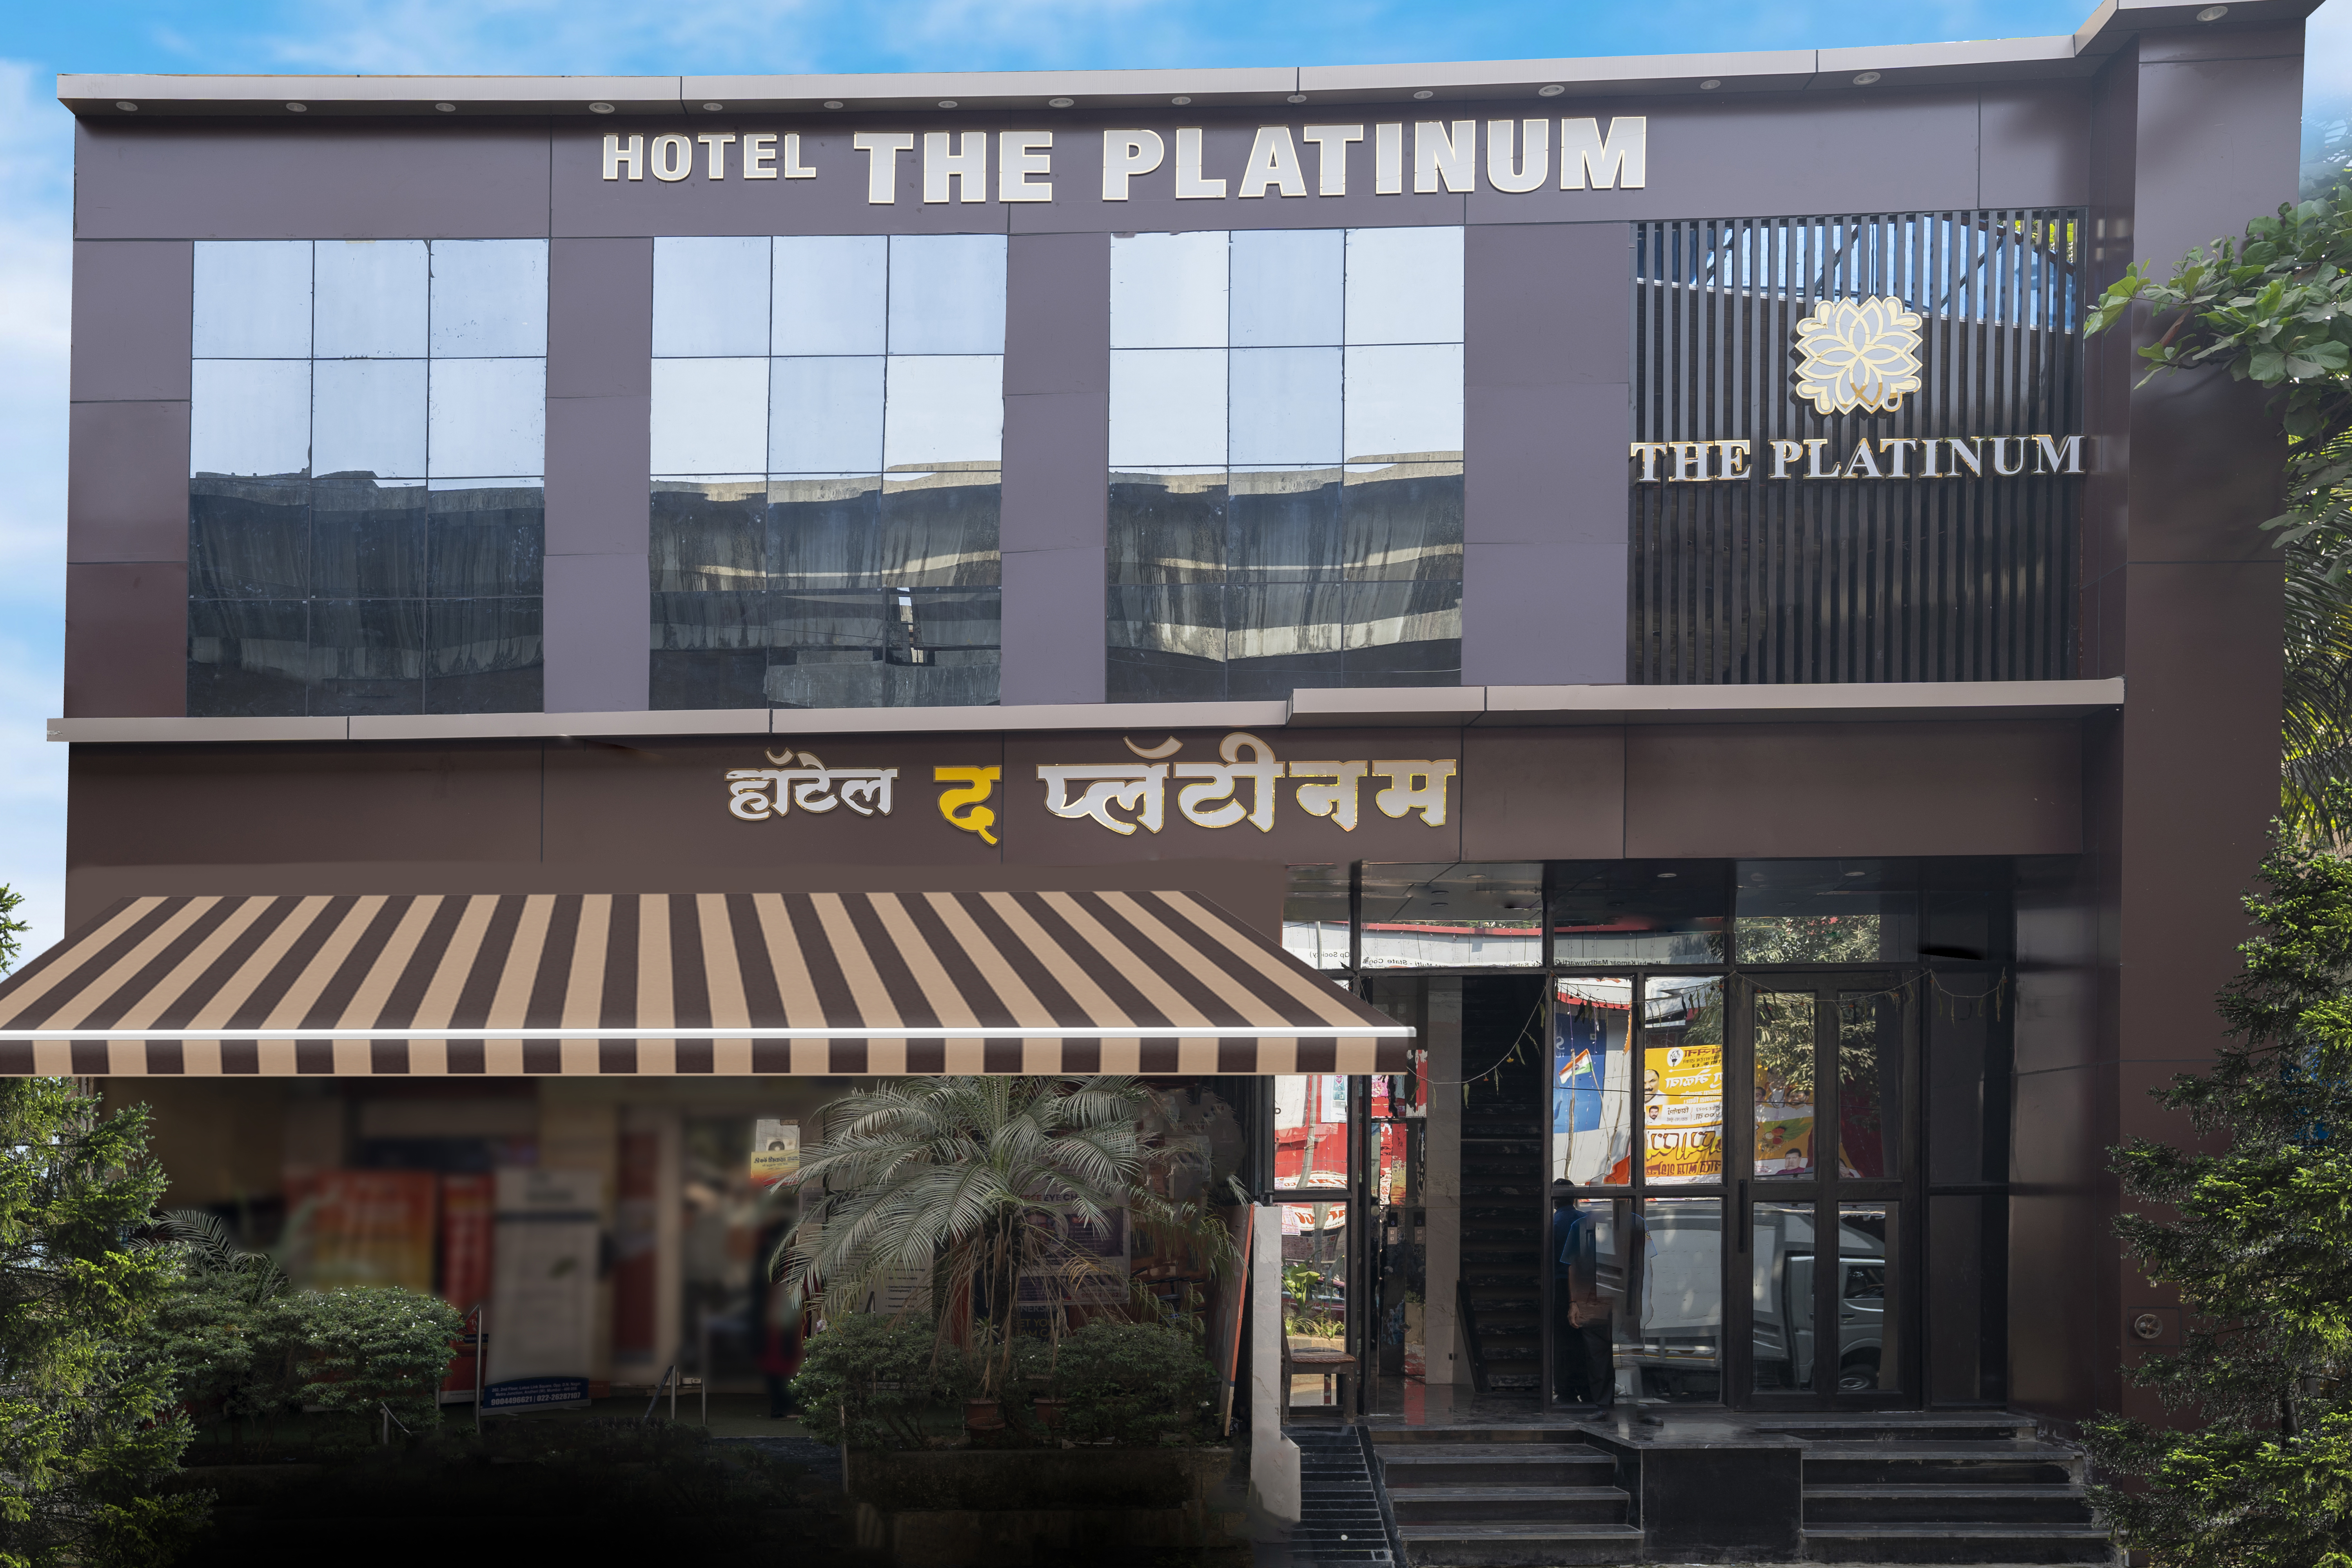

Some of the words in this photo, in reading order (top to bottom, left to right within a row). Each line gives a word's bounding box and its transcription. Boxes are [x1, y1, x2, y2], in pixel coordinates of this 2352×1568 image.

[603, 132, 817, 181] HOTEL
[854, 130, 1053, 204] THE
[1102, 116, 1646, 201] PLATINUM
[1631, 439, 1751, 483] THE
[1768, 434, 2086, 480] PLATINUM
[725, 748, 900, 821] हॉटेल
[933, 764, 1002, 847] द
[1036, 732, 1457, 836] प्लॅटीनम
[491, 1396, 532, 1406] 9004496621
[537, 1392, 581, 1402] 022-26287107
